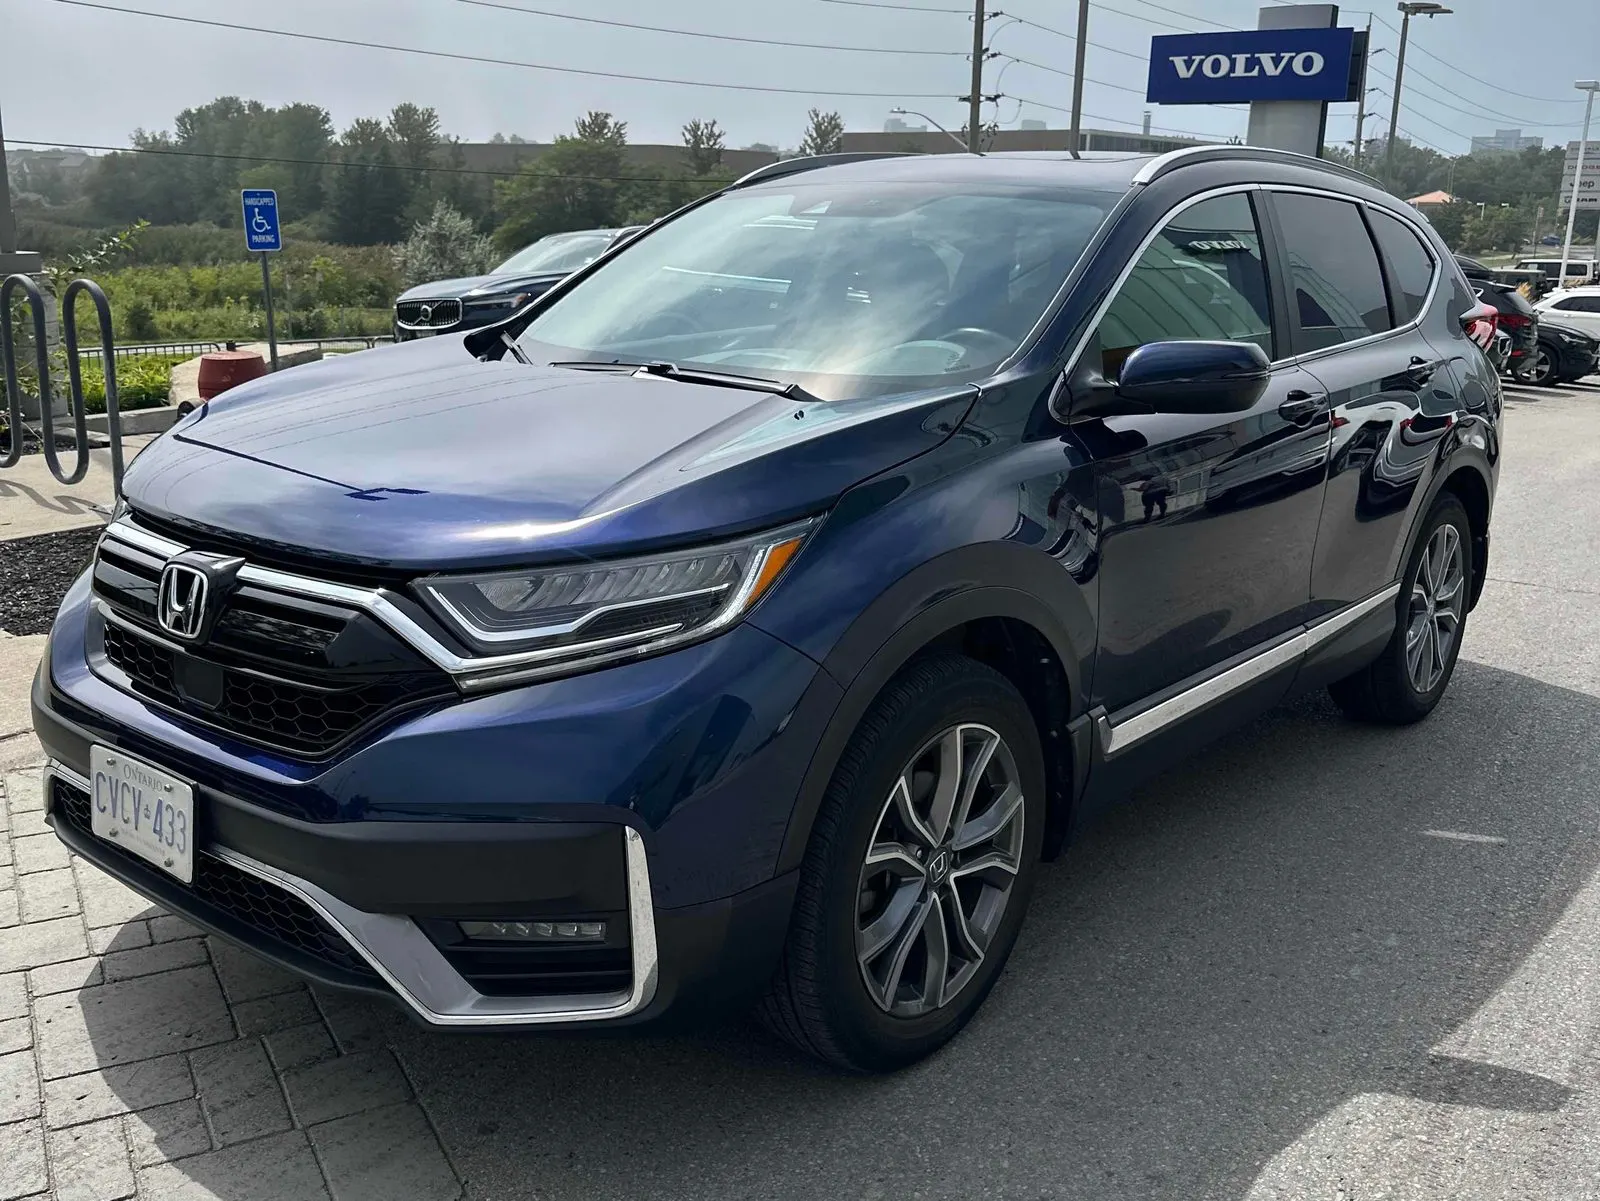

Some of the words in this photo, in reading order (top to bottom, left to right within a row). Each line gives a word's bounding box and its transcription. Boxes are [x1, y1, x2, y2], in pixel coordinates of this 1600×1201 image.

[1169, 51, 1325, 79] VOLVO
[245, 197, 274, 206] HANDICAPPED
[252, 234, 275, 243] PARKING
[123, 764, 163, 792] ONTARIO
